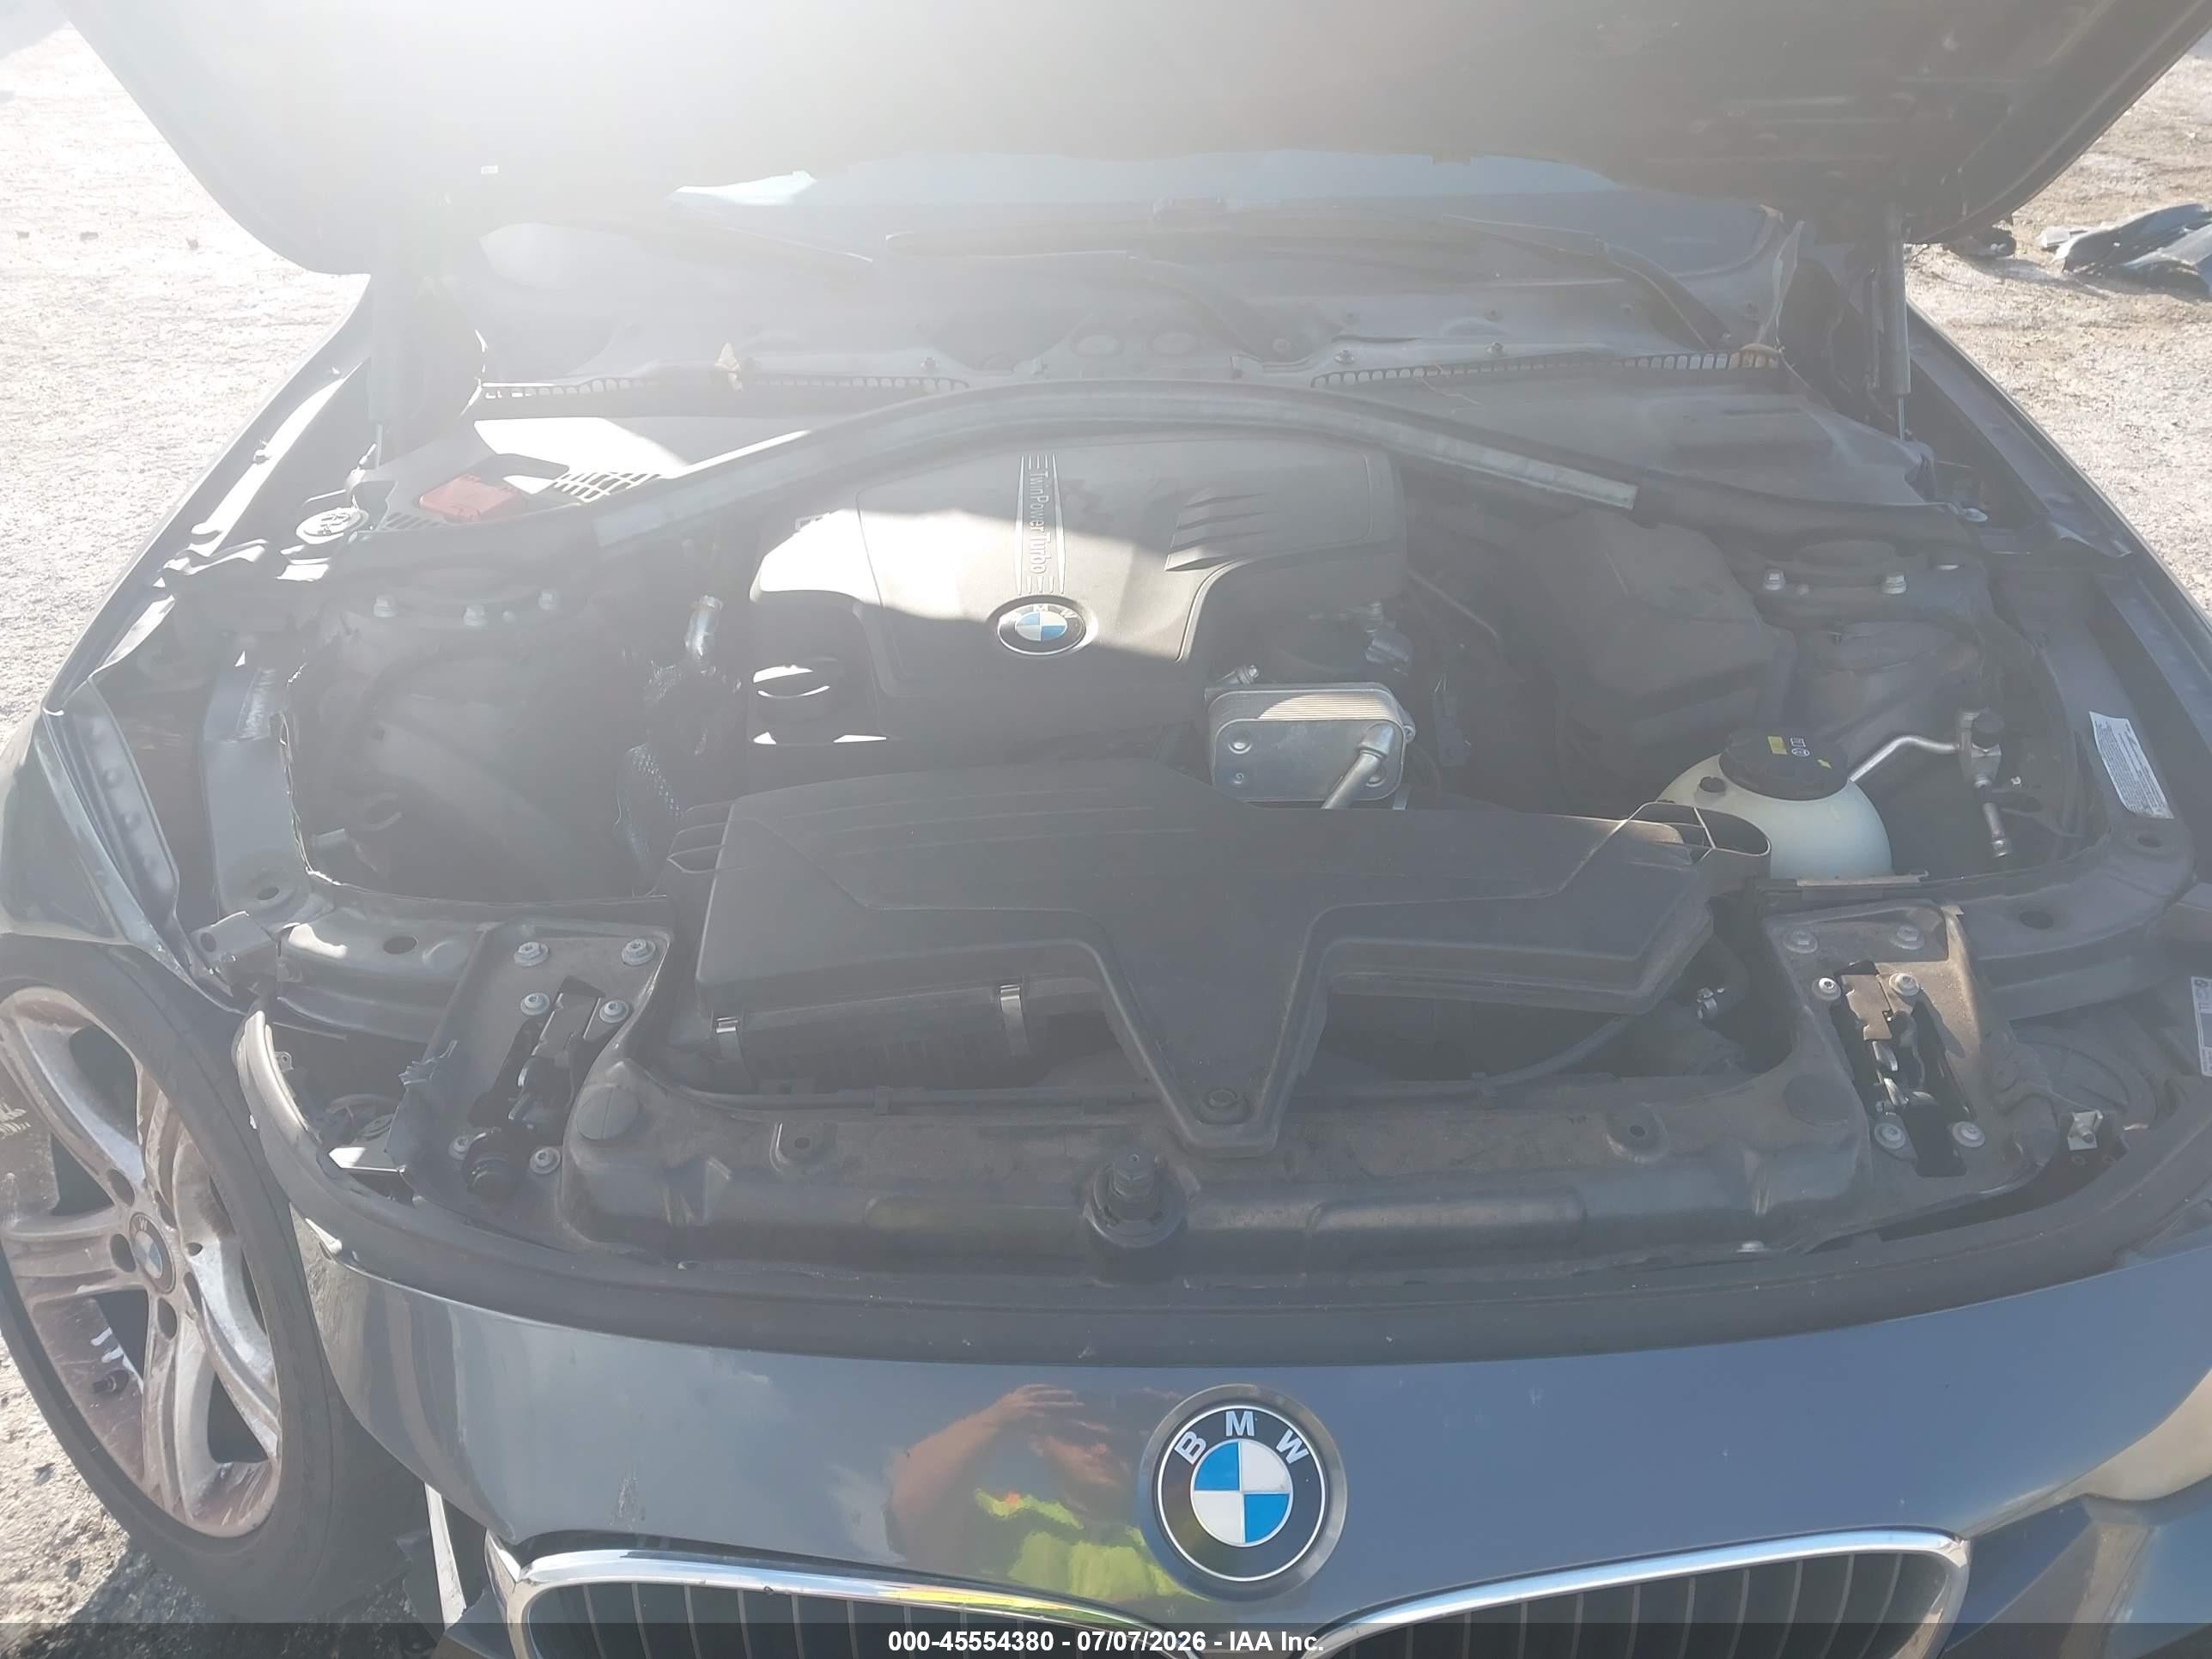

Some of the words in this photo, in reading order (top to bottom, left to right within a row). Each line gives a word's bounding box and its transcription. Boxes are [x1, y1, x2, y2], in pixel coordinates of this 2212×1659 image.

[1029, 471, 1050, 532] TwinPower
[1029, 532, 1052, 574] Turbo
[1174, 1410, 1310, 1465] BMW
